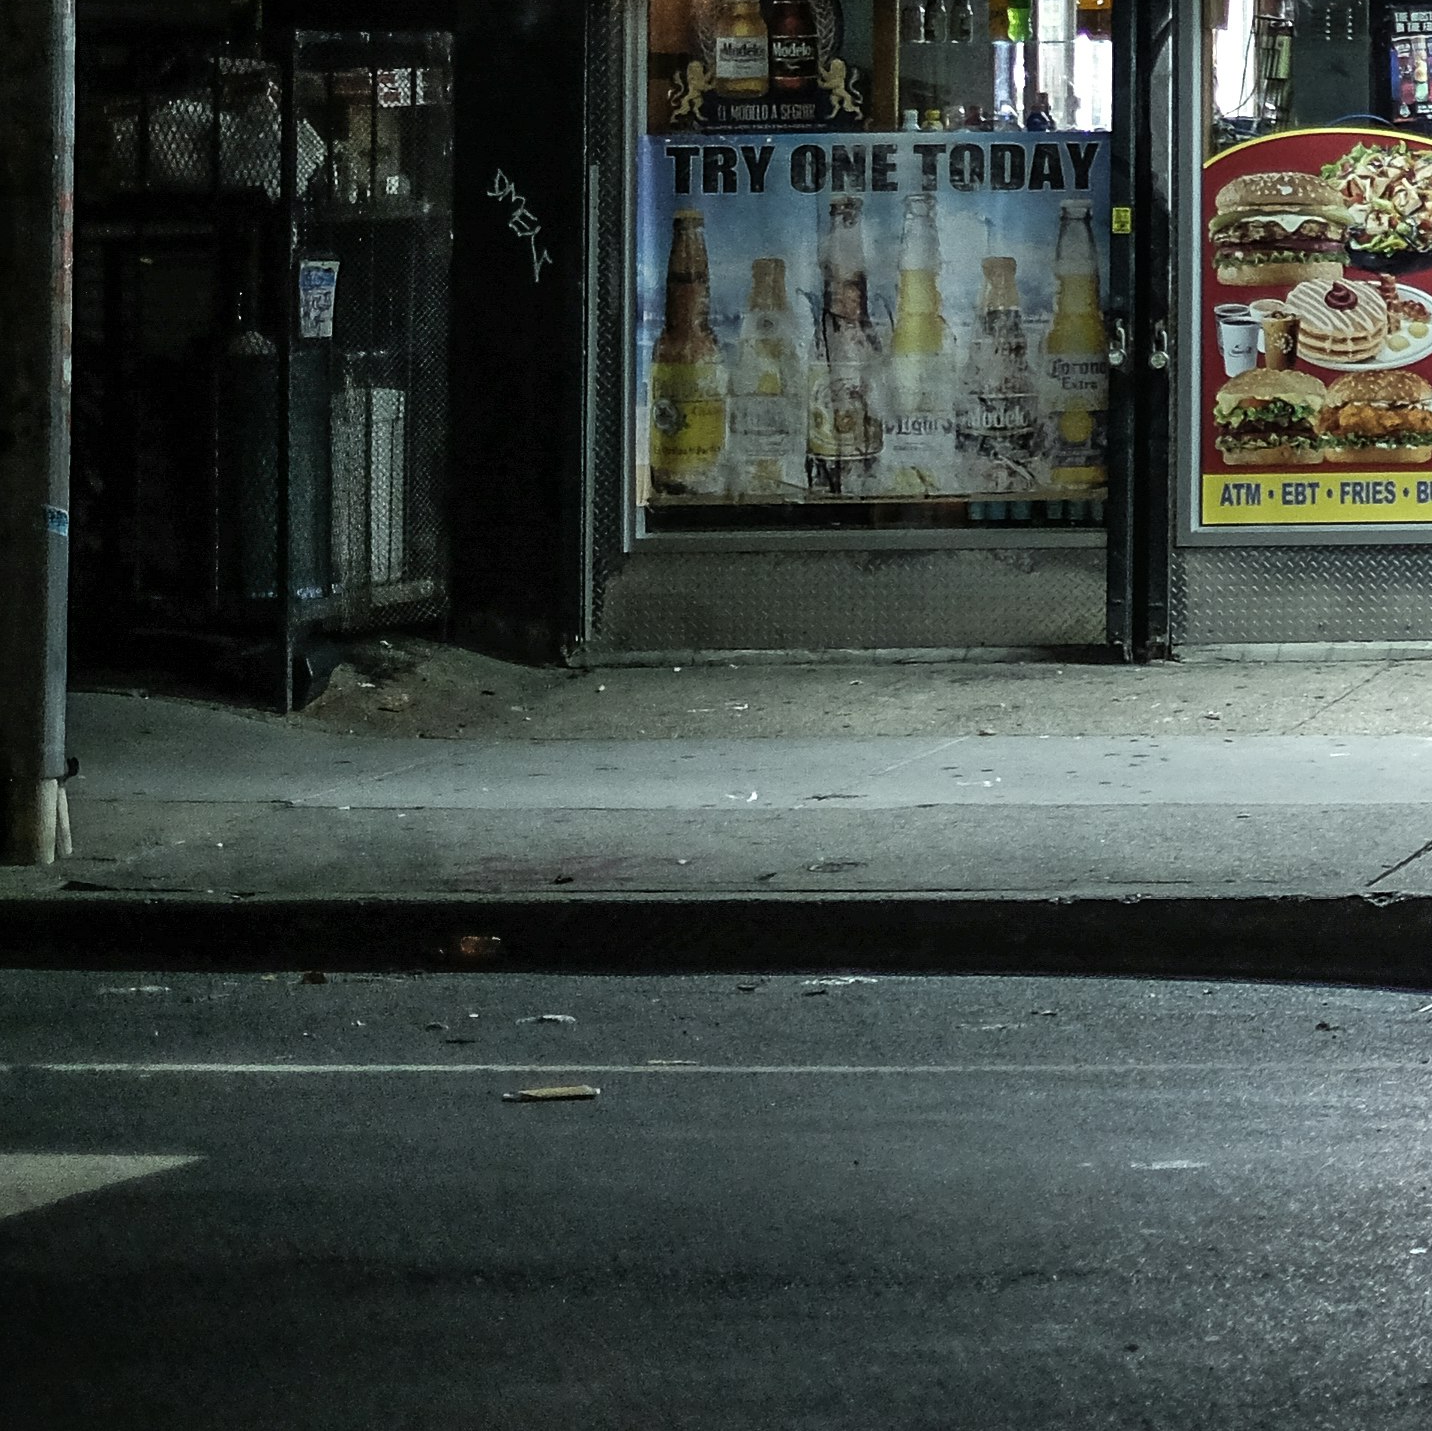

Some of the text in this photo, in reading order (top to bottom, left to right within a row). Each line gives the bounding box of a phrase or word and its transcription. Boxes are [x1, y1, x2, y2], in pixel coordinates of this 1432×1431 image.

[667, 142, 1099, 193] TRY ONE TODAY
[1061, 376, 1098, 391] Extra
[1220, 481, 1262, 506] ATM
[1282, 480, 1319, 505] EBT
[1339, 479, 1396, 504] FRIES
